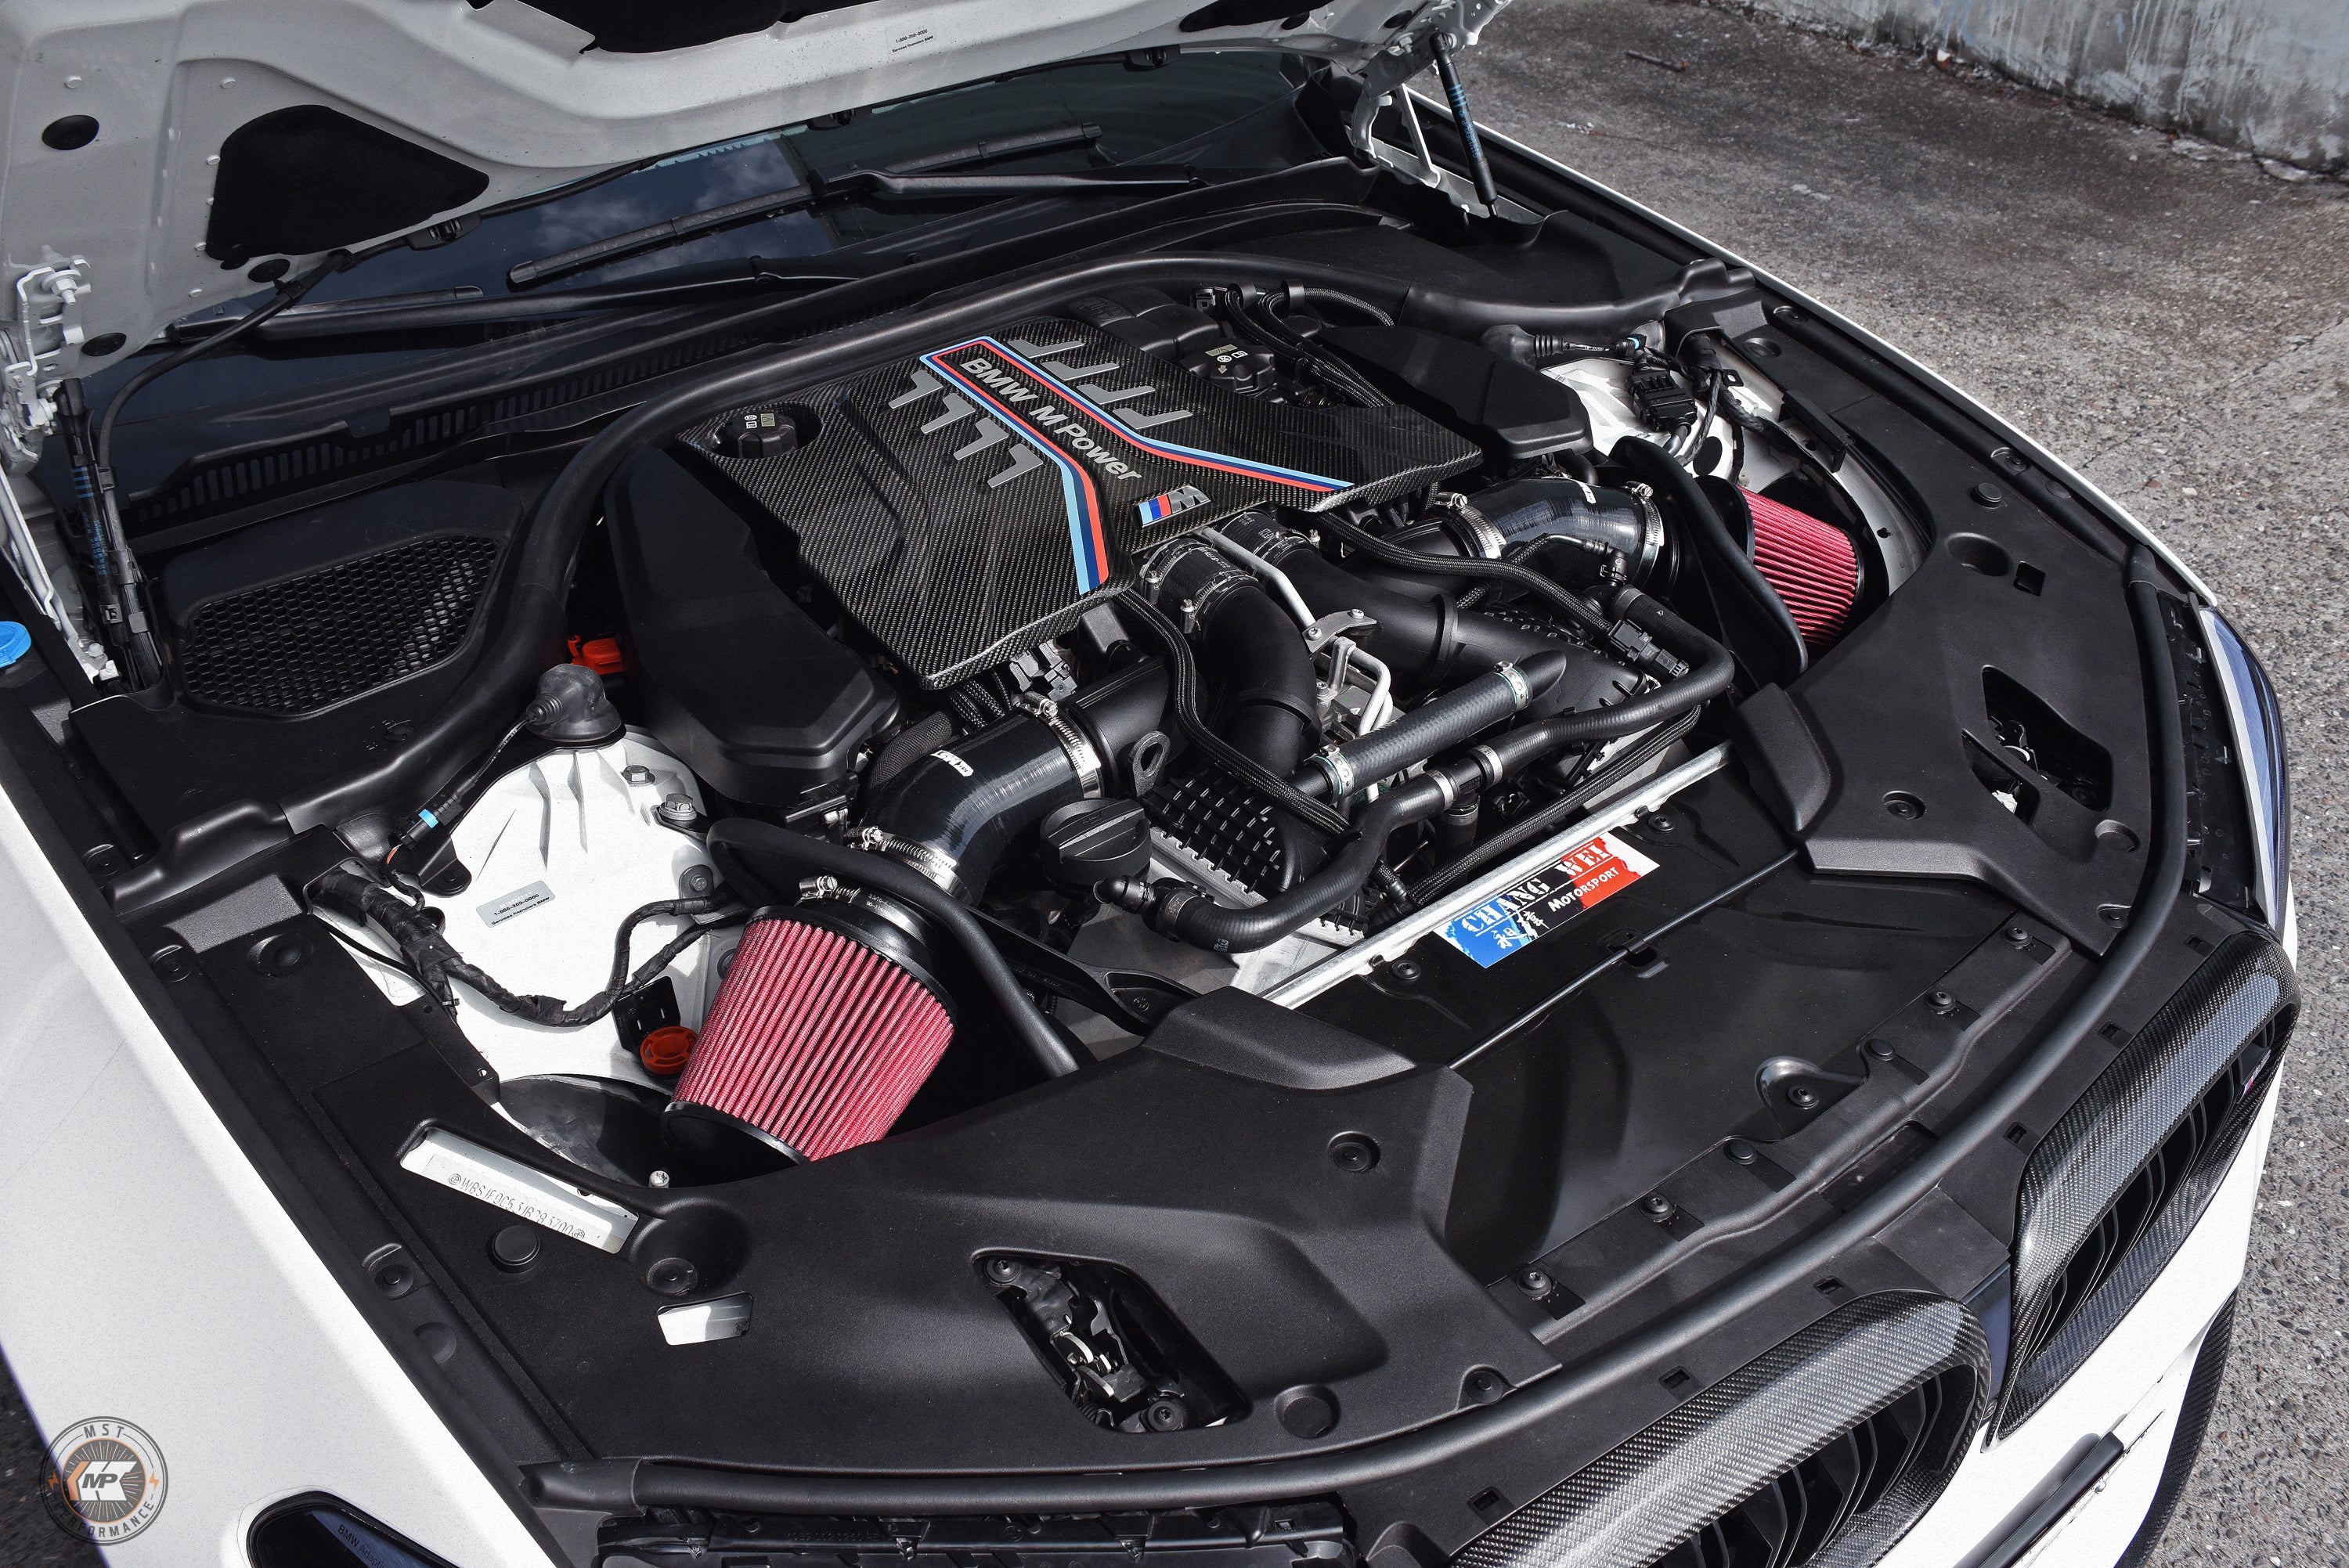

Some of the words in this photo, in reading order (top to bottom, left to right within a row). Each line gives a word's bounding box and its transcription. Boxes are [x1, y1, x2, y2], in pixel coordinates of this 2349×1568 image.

[960, 358, 1038, 402] BMW
[1029, 405, 1069, 426] M
[1055, 423, 1142, 480] Power
[1462, 877, 1550, 933] CHANG
[1555, 844, 1612, 878] WEI
[337, 1524, 360, 1548] BMW
